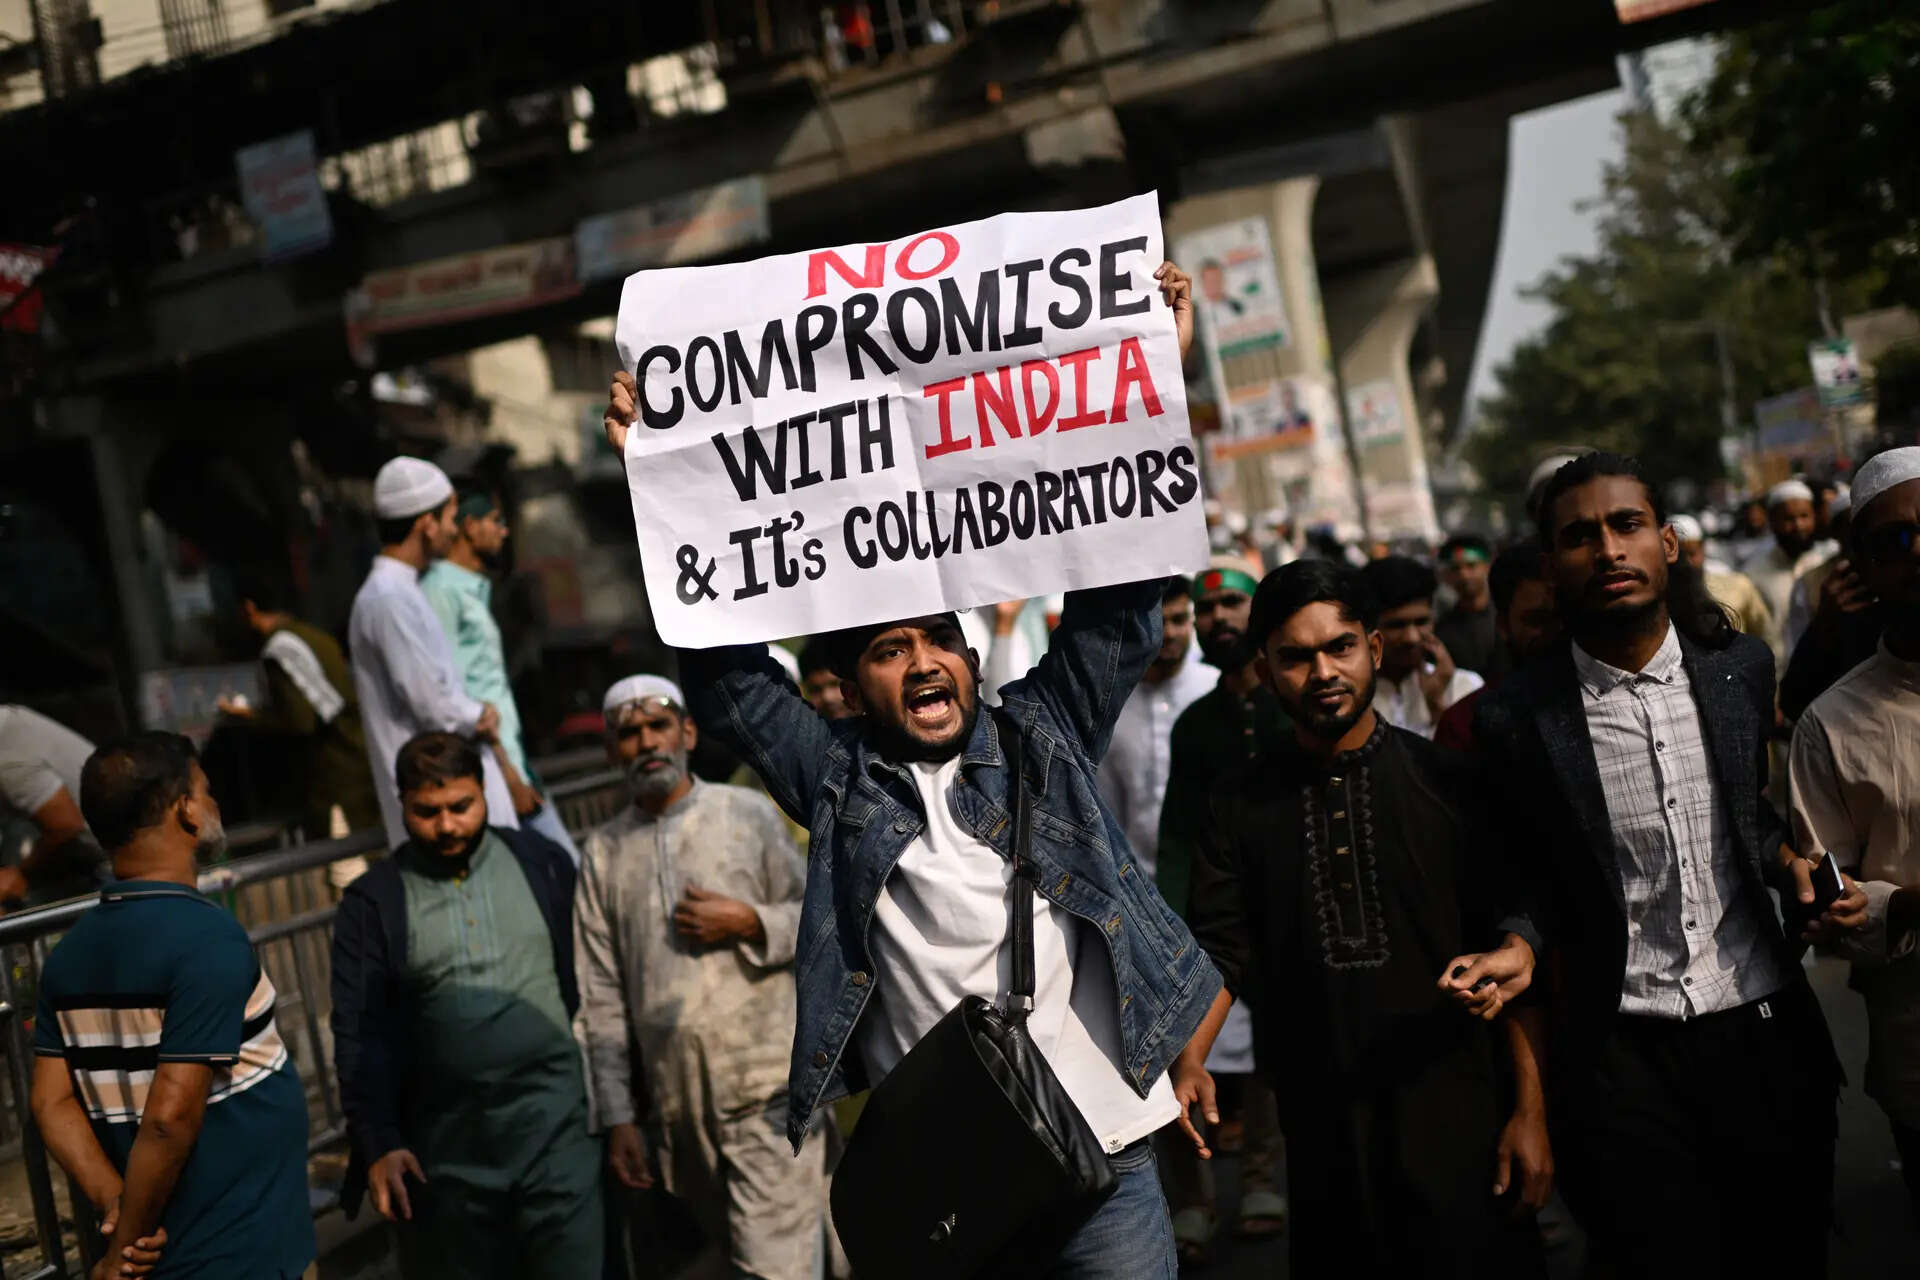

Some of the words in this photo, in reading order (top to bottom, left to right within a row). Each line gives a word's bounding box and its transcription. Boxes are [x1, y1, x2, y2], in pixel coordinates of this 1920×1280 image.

[636, 235, 1151, 430] COMPROMISE
[803, 231, 960, 300] NO
[711, 394, 895, 501] WITH
[922, 336, 1164, 459] INDIA
[676, 544, 719, 605] &
[843, 445, 1198, 569] COLLABORATORS
